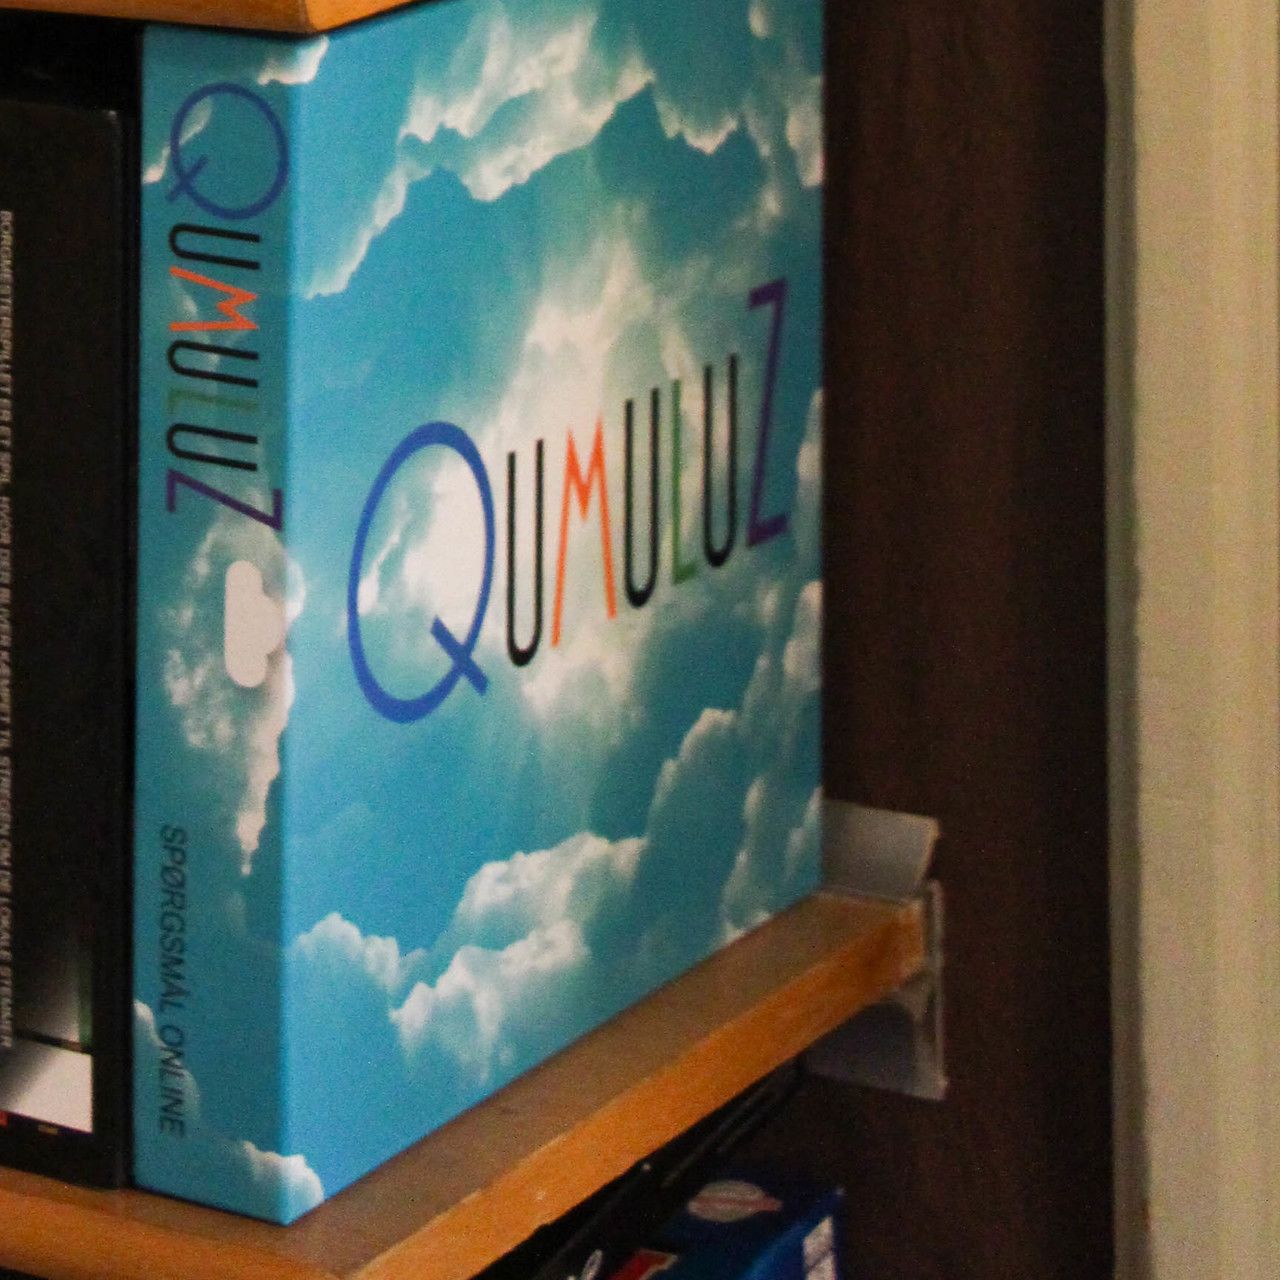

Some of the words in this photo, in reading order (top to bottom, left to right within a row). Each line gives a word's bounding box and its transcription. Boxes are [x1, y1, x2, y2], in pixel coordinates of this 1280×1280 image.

[165, 82, 287, 531] QUMULUZ
[347, 277, 789, 724] QUMULUZ
[160, 1023, 186, 1138] ONLINE
